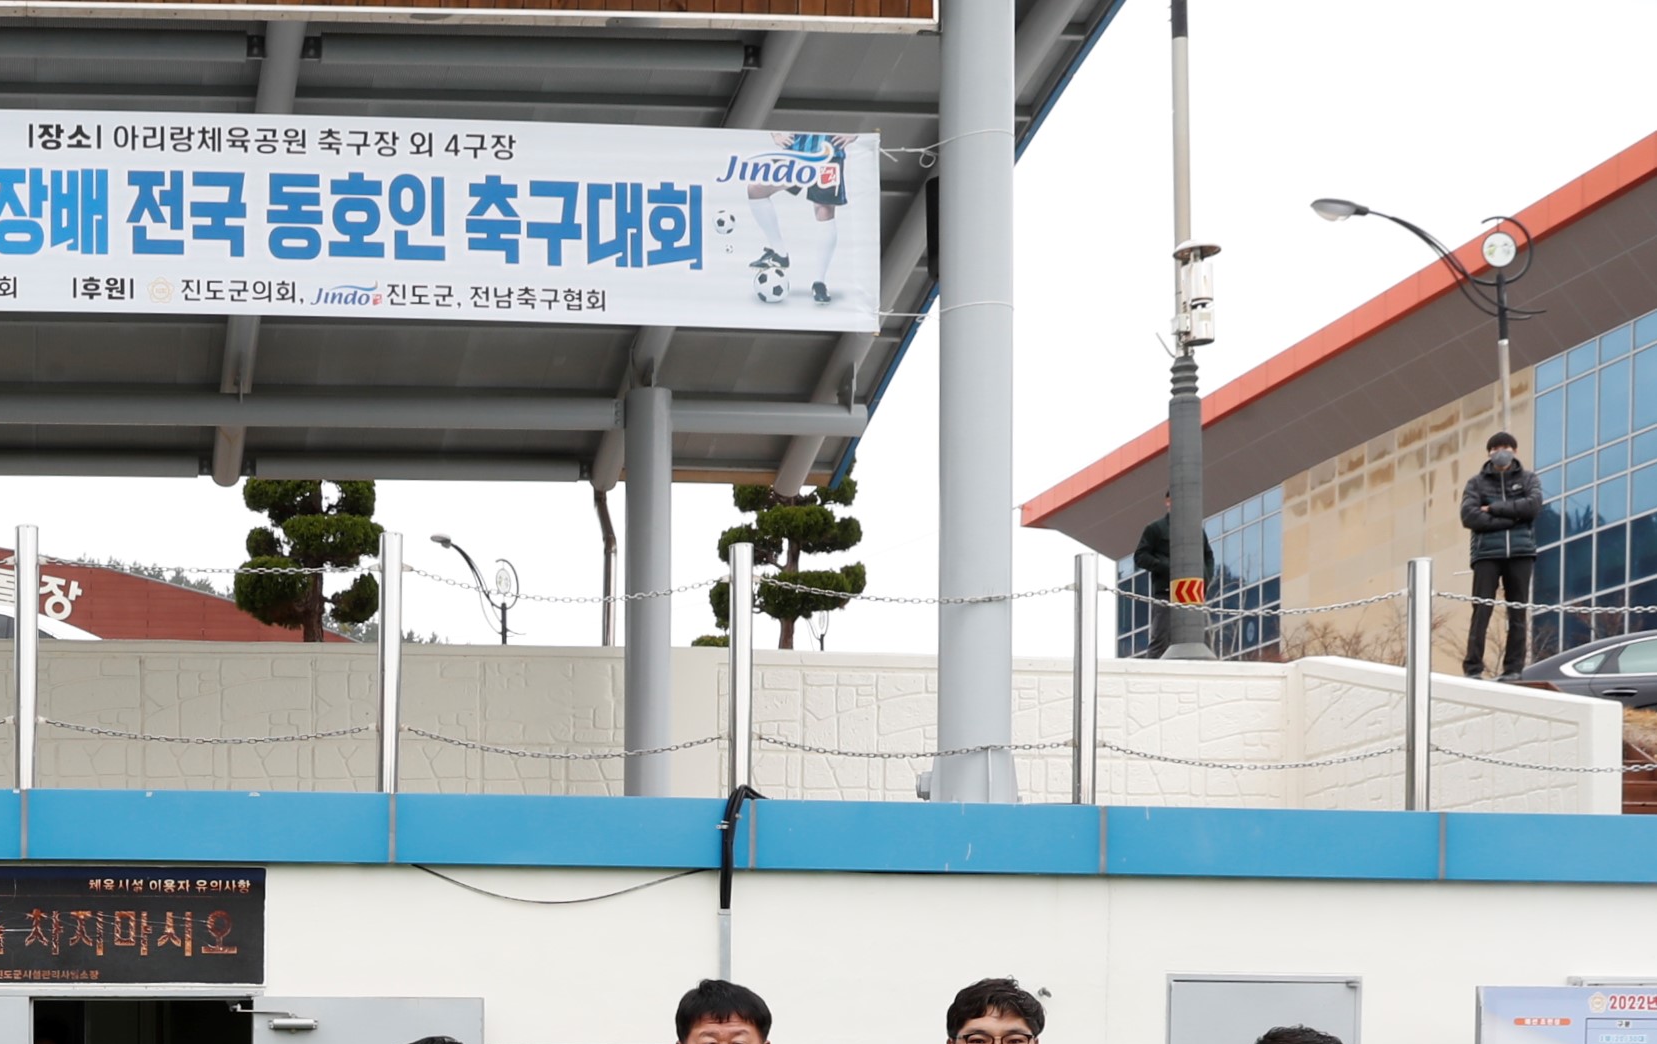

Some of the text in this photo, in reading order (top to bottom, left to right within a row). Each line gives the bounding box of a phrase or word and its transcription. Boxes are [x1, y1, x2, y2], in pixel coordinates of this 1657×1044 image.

[112, 124, 308, 156] 아리랑체육공원
[317, 127, 400, 158] 축구장
[409, 129, 435, 157] 외
[444, 131, 517, 161] 4구장
[716, 152, 818, 187] Jindo
[125, 168, 249, 258] 전국
[266, 170, 446, 262] 동호인
[465, 174, 704, 271] 축구대회
[469, 284, 608, 313] 전남축구협회
[149, 879, 190, 893] 이용자
[196, 879, 251, 894] 유의사항
[24, 908, 238, 957] 차지마시오
